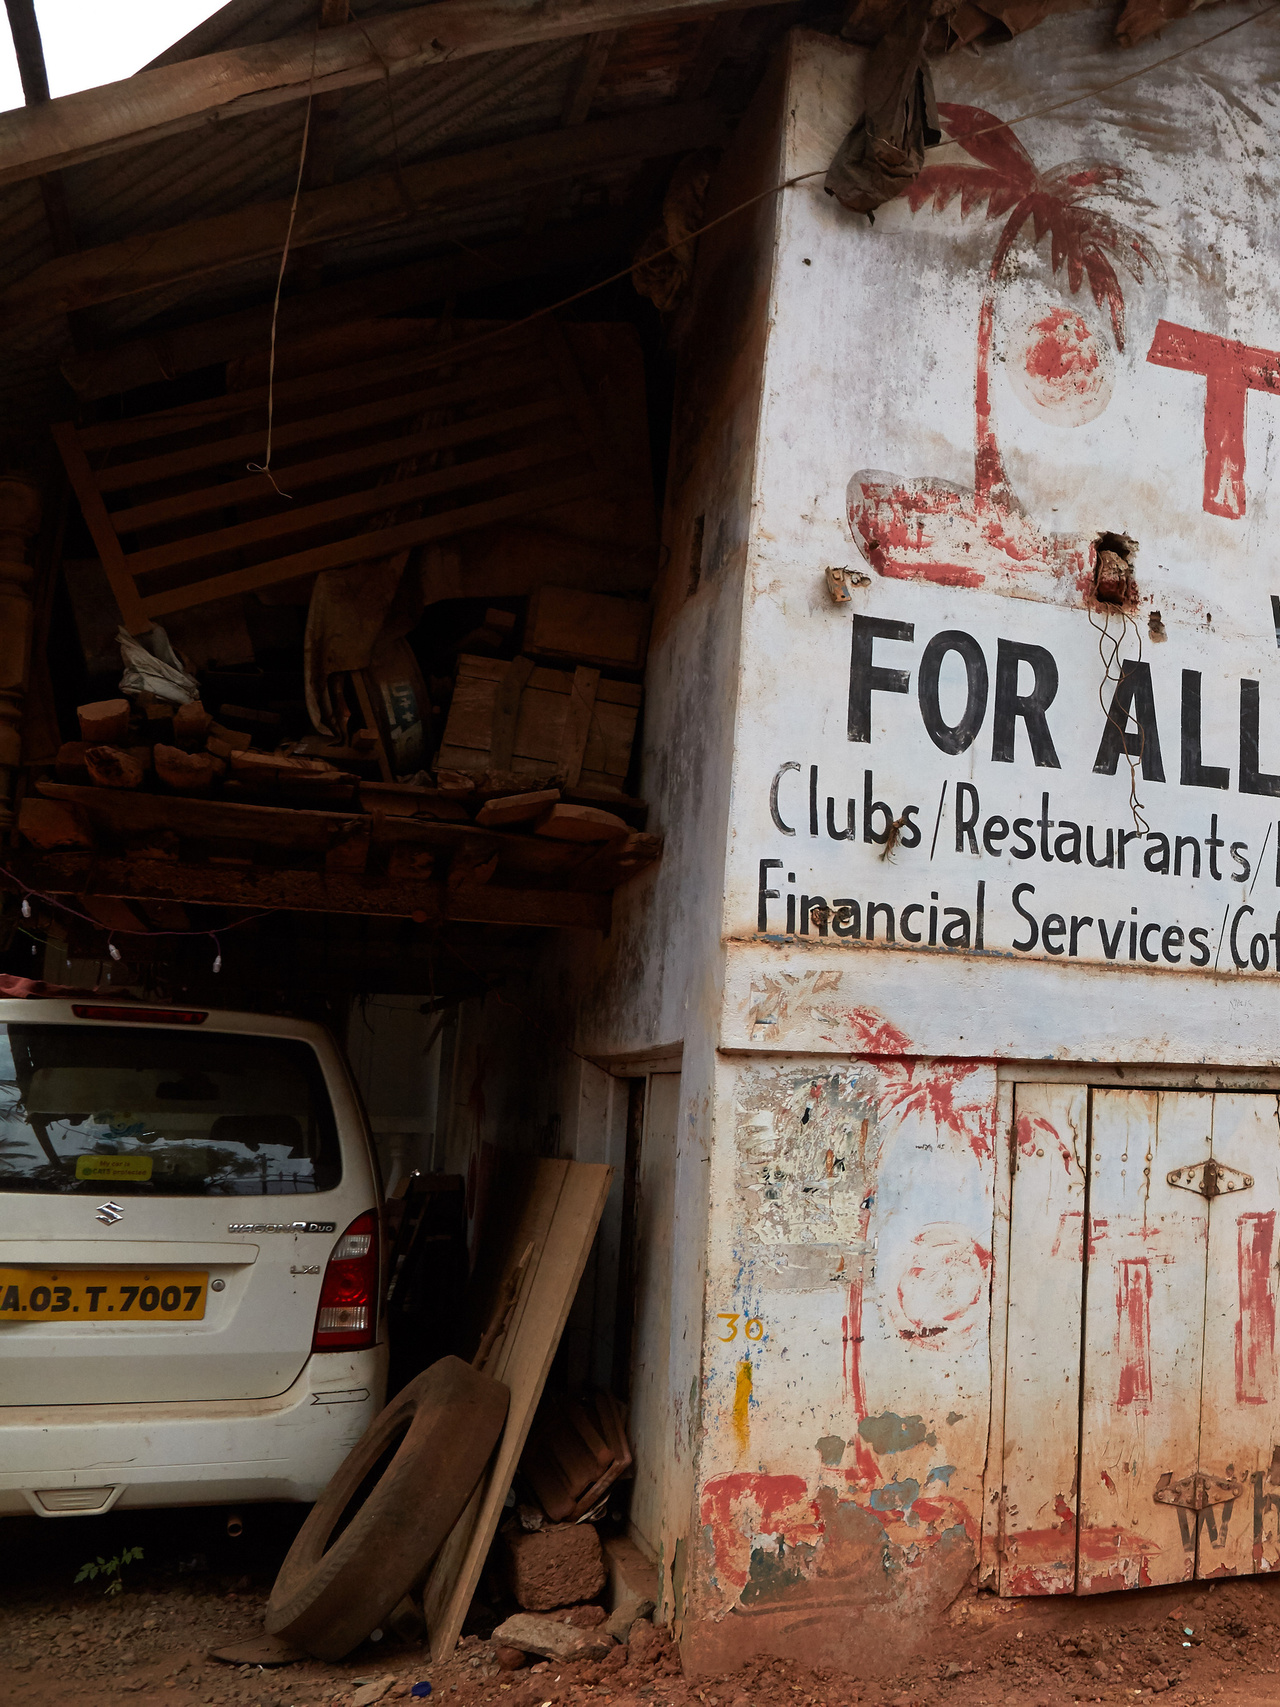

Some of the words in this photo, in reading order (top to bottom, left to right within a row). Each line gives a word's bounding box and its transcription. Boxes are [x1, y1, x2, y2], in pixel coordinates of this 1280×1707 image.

[847, 613, 1062, 769] FOR
[757, 858, 986, 951] Financial
[717, 1312, 764, 1343] 30
